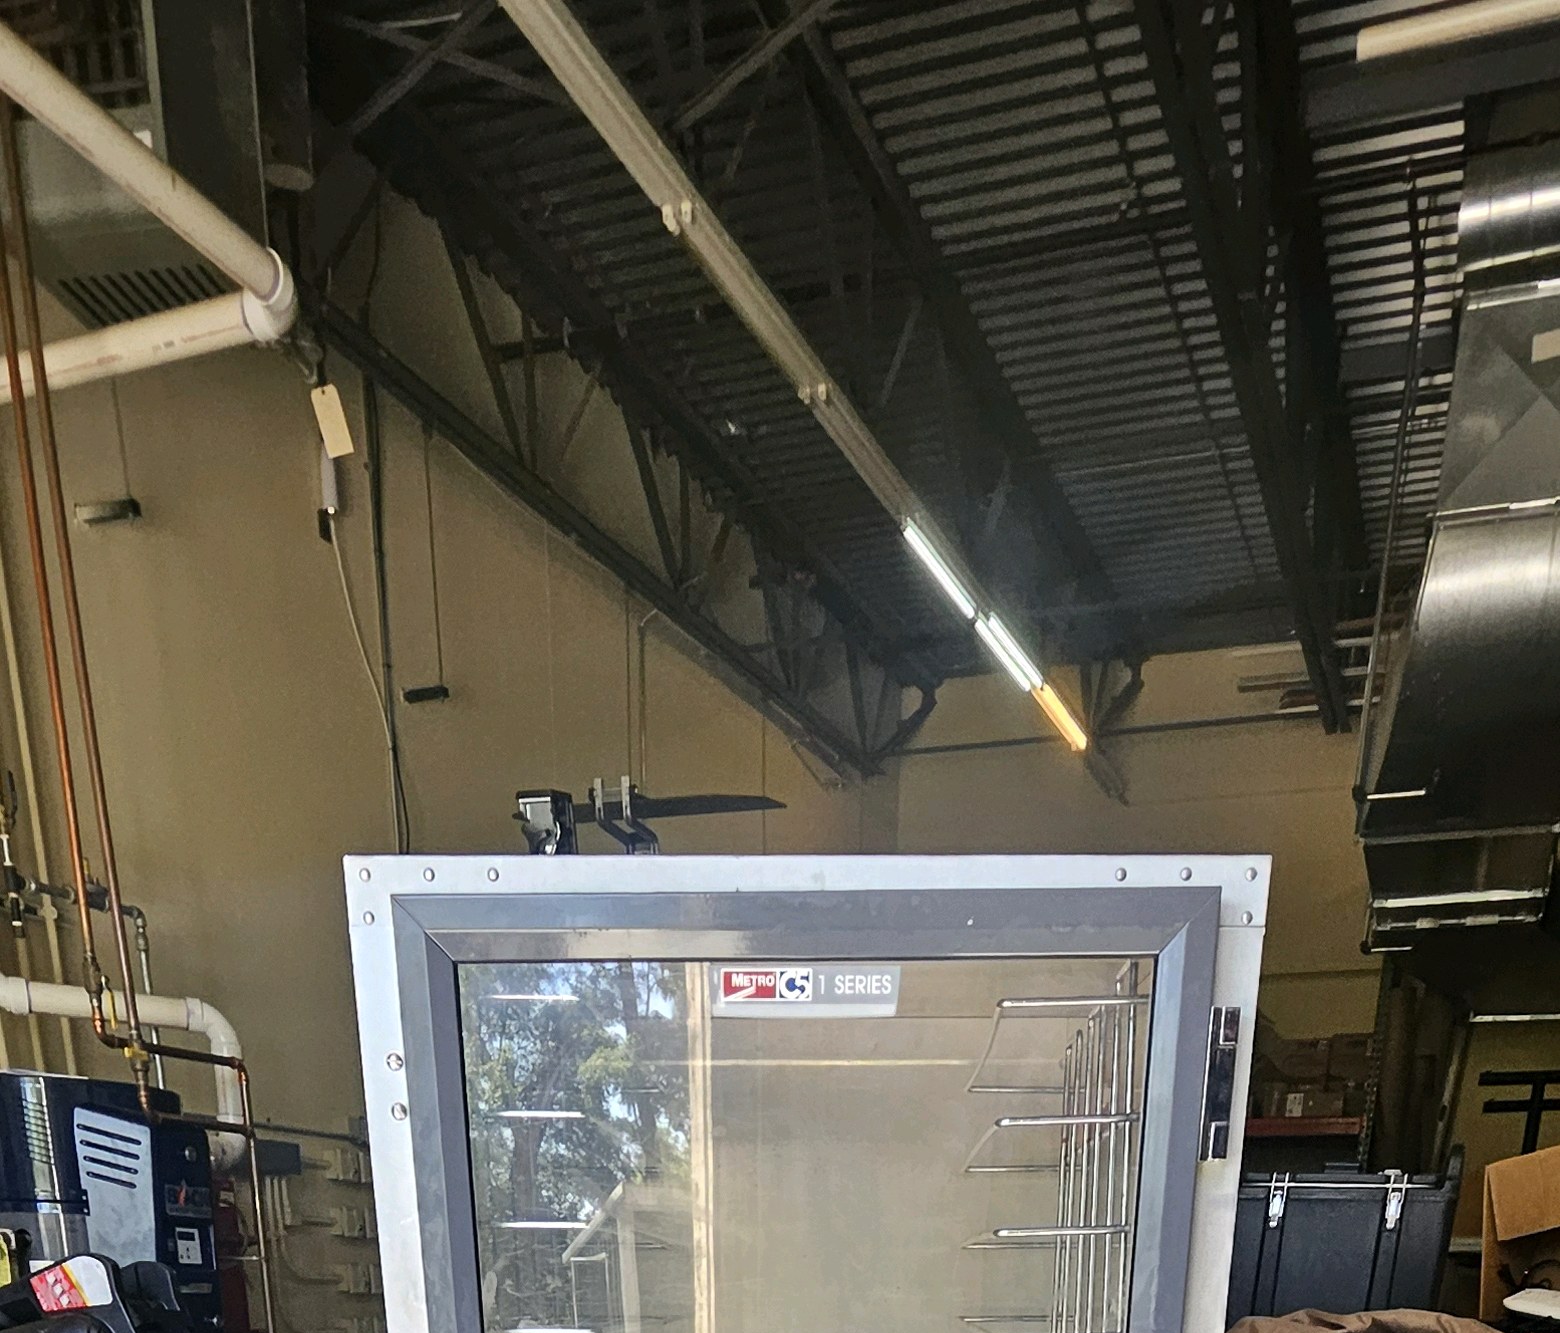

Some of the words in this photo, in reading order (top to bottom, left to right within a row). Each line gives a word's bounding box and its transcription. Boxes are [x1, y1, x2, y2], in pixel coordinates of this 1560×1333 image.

[731, 972, 776, 988] METRO
[779, 971, 809, 999] C5
[818, 975, 825, 995] 1
[834, 975, 892, 995] SERIES
